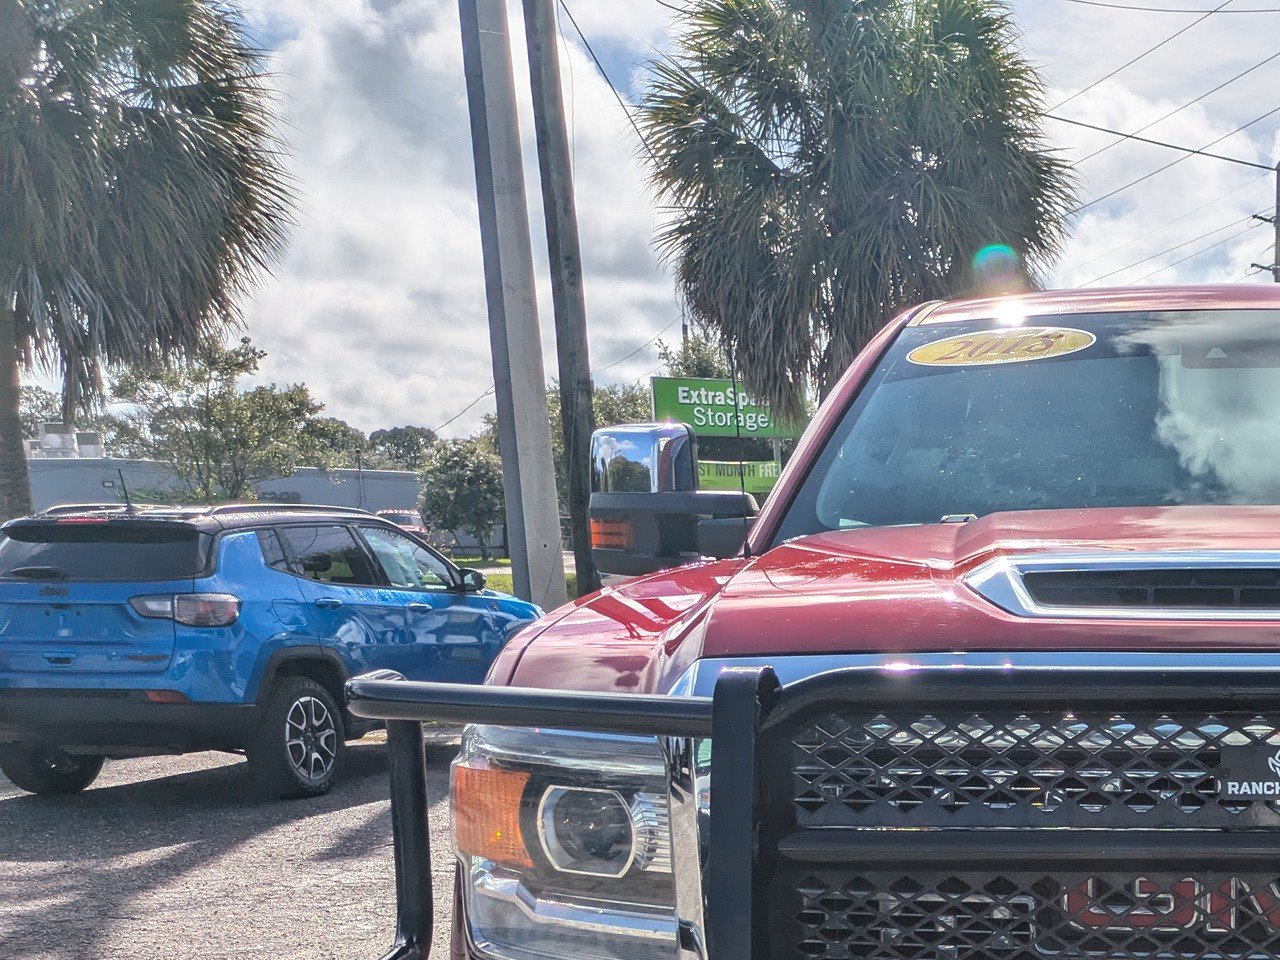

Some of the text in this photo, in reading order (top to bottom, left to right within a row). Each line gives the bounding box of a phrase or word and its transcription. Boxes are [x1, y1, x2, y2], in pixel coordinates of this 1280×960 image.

[678, 386, 770, 410] ExtraSp
[715, 464, 756, 478] MONTH
[759, 464, 780, 479] FRE
